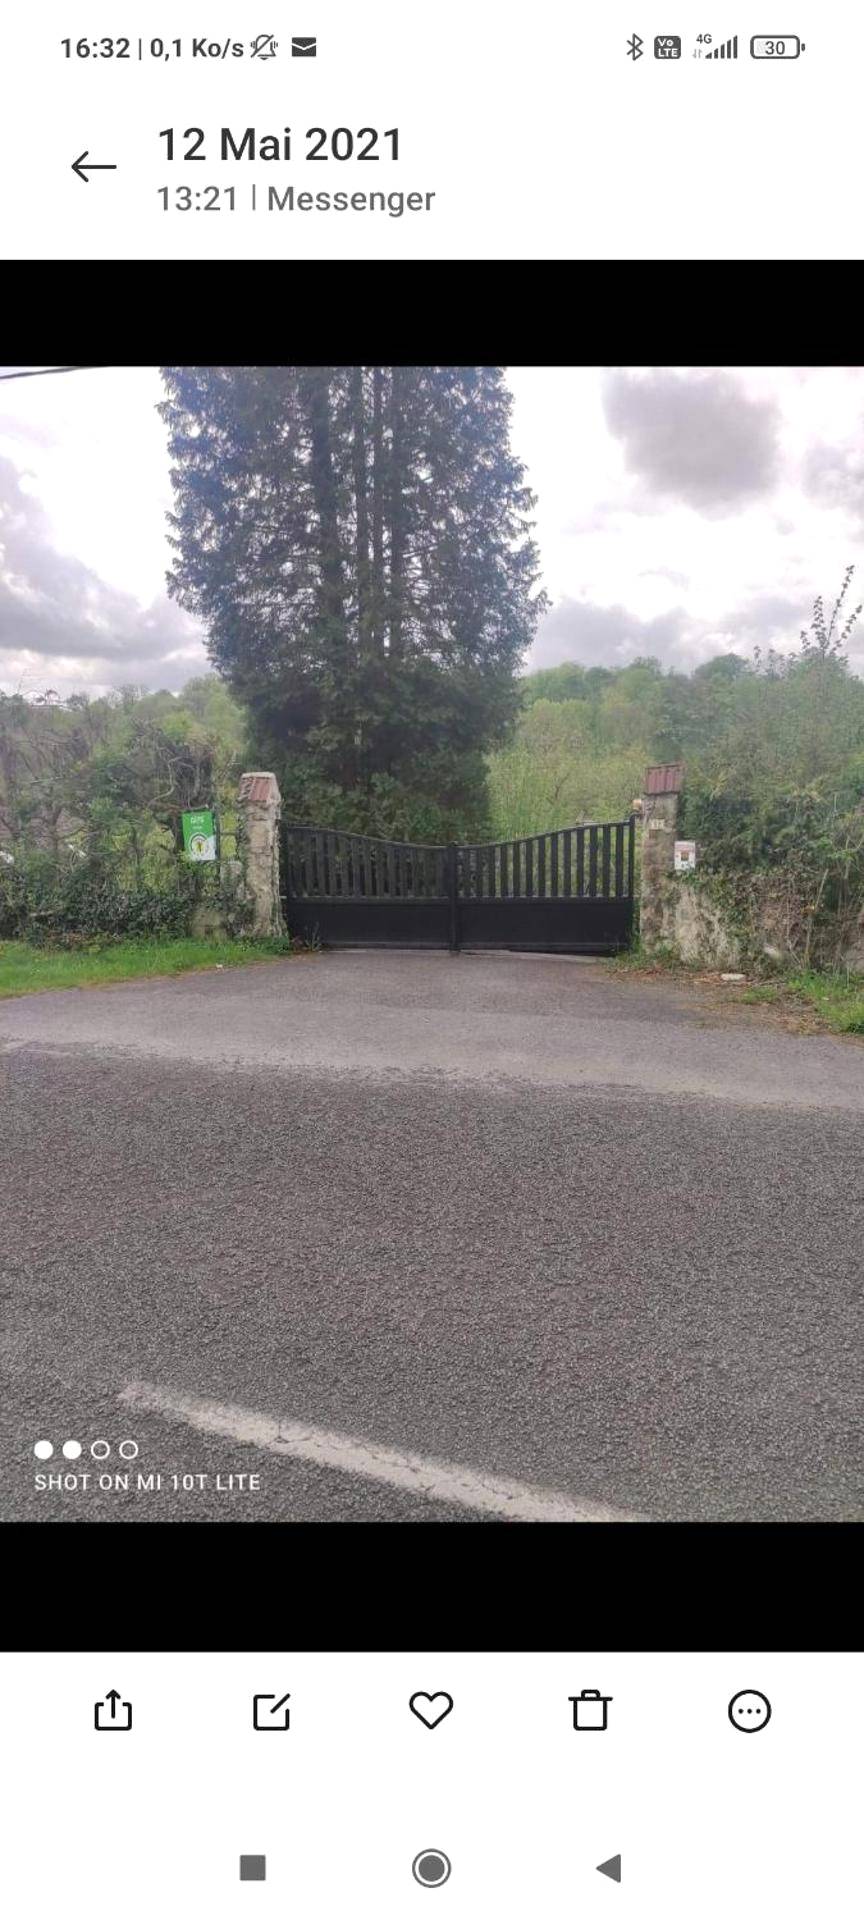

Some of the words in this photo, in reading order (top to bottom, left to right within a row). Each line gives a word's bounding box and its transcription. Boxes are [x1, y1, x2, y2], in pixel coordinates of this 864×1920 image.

[657, 38, 674, 47] Vo
[696, 33, 712, 44] 4G
[61, 38, 131, 59] 16:32
[151, 38, 182, 61] 0,1
[193, 38, 244, 60] Ko/s
[658, 48, 678, 57] LTE
[764, 40, 786, 55] 30
[159, 127, 206, 161] 12
[221, 127, 291, 161] Mai
[306, 127, 401, 161] 2021
[157, 186, 236, 212] 13:21
[268, 186, 436, 218] Messenger
